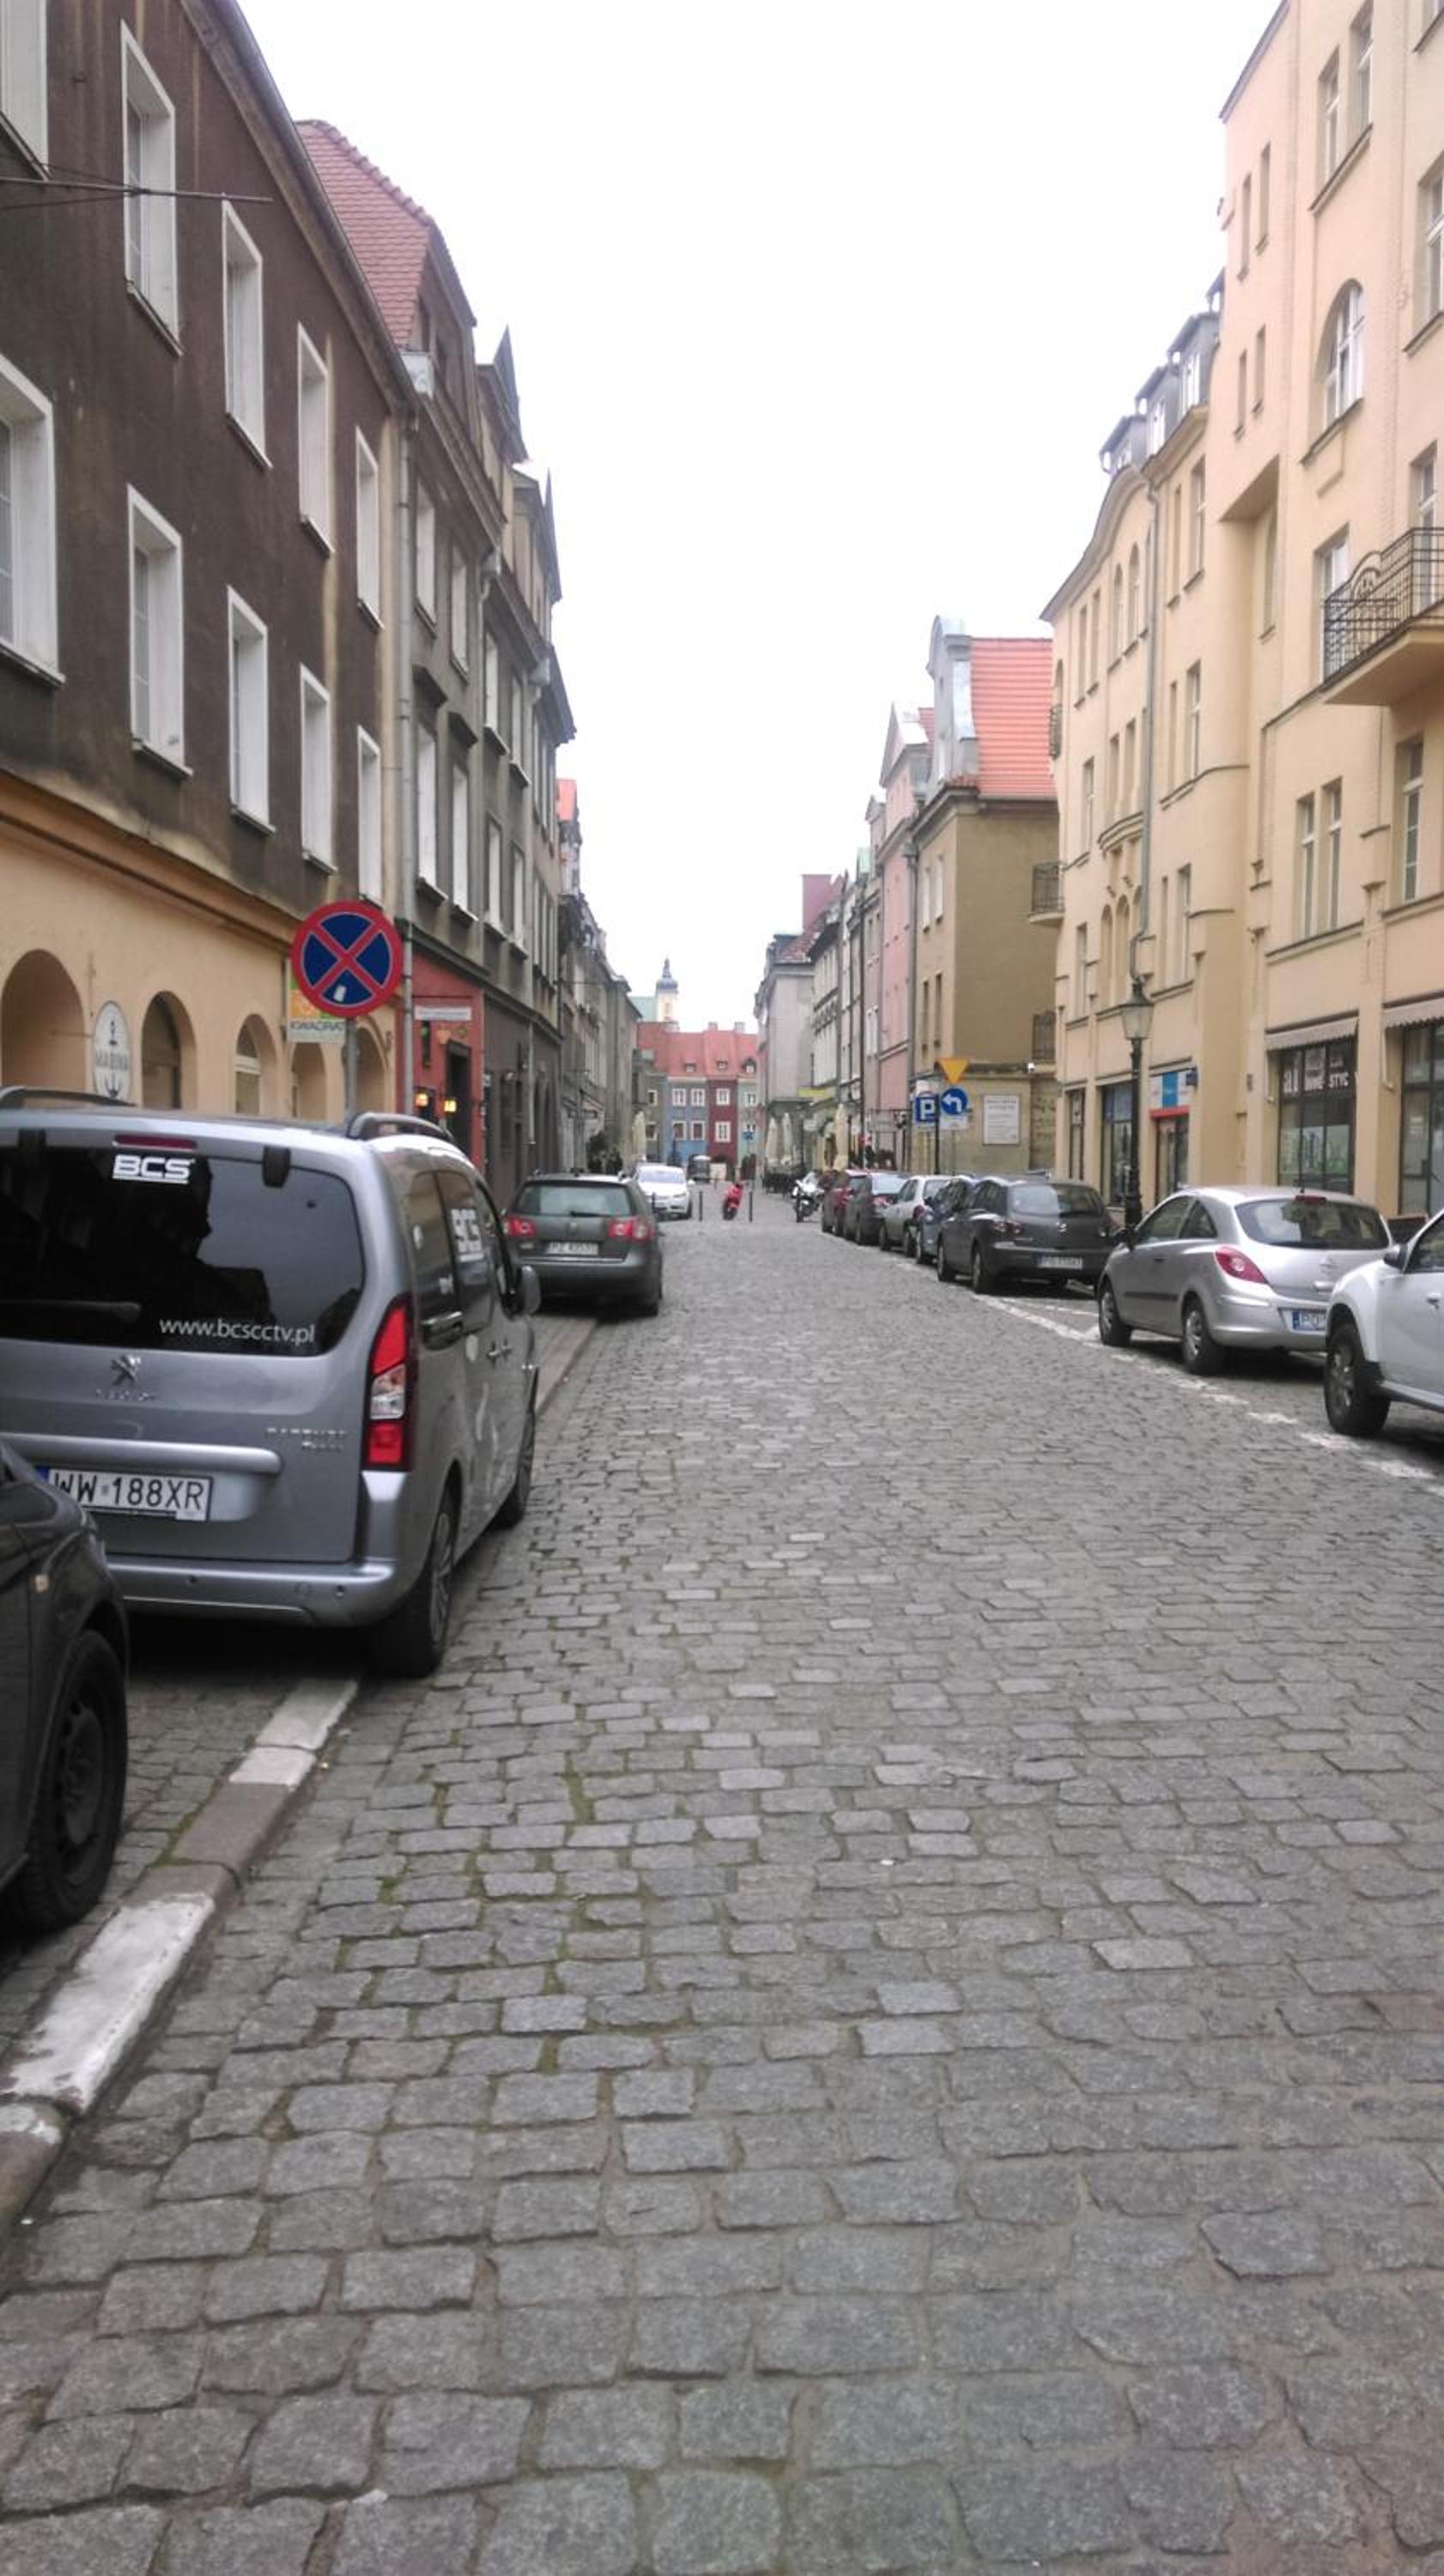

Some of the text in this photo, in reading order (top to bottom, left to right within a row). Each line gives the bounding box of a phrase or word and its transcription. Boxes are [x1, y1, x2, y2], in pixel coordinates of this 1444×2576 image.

[919, 1099, 936, 1120] P
[112, 1154, 191, 1179] BCS
[159, 1317, 316, 1346] www.bcscctv.pl
[112, 1476, 204, 1511] 188XR
